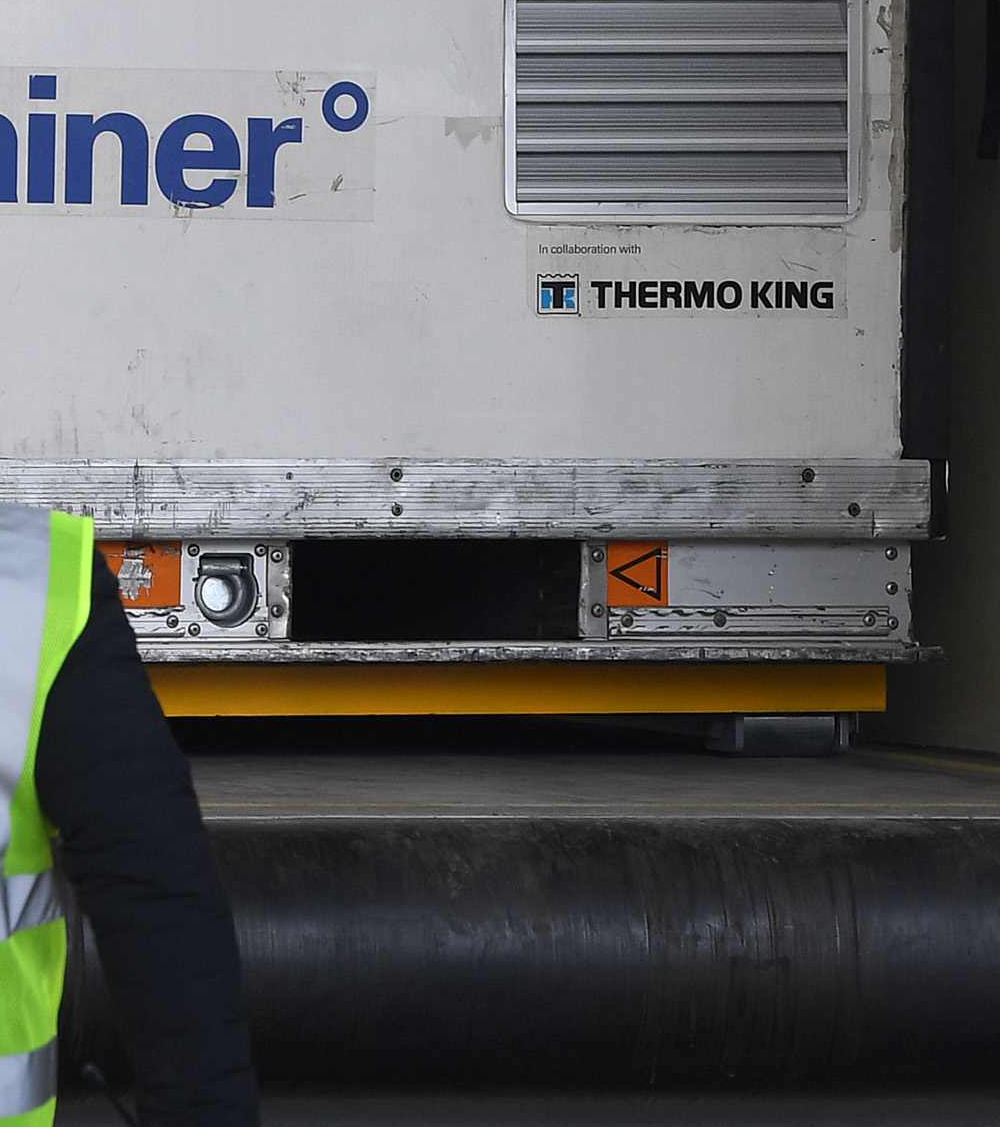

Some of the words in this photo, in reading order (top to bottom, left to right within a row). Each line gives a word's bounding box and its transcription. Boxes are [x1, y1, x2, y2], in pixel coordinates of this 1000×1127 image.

[538, 244, 548, 255] In
[550, 244, 617, 255] collaboration
[619, 244, 642, 255] with
[591, 280, 743, 311] THERMO
[750, 280, 834, 310] KING
